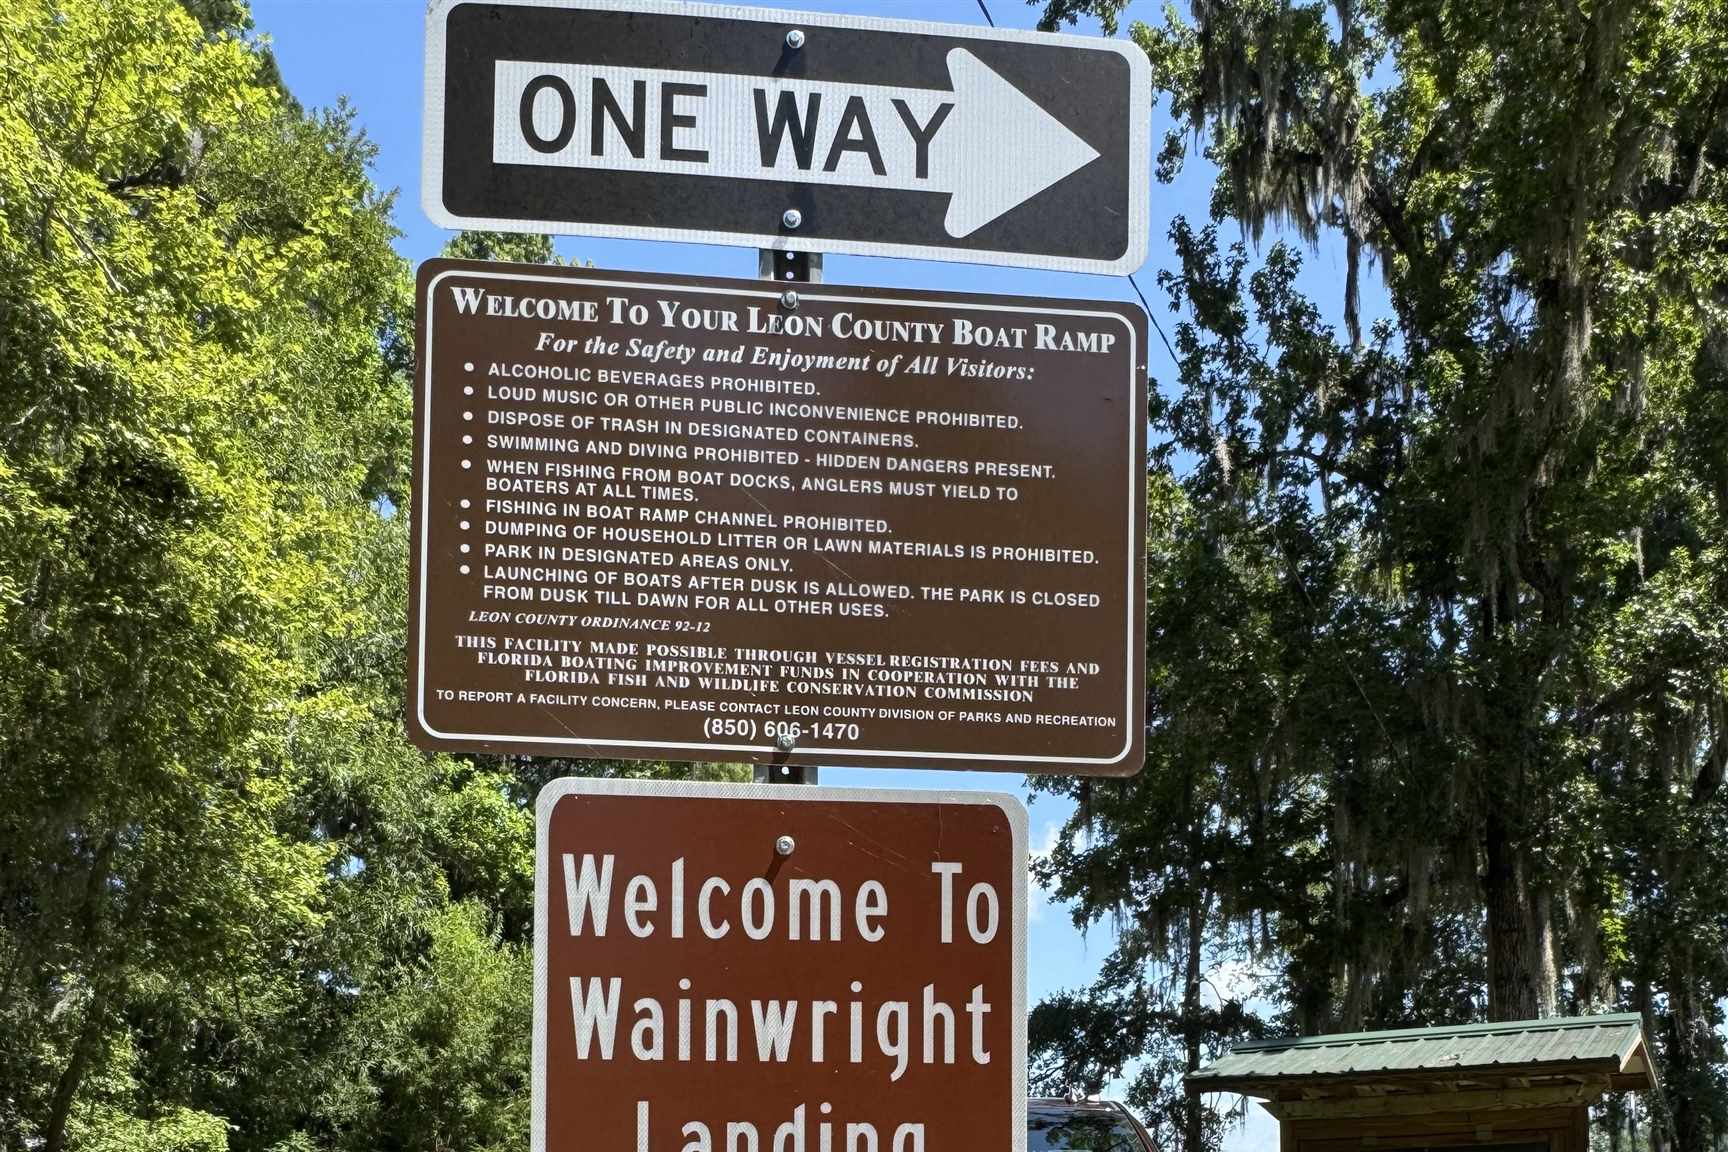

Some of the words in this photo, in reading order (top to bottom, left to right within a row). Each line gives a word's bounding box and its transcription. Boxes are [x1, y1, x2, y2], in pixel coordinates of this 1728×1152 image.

[518, 74, 710, 163] ONE
[751, 88, 955, 179] WAY
[449, 286, 599, 323] WELCOME
[606, 296, 649, 326] TO
[656, 300, 740, 332] YOUR
[746, 305, 824, 338] LEON
[831, 312, 945, 344] COUNTY
[951, 318, 1028, 349] BOAT
[1033, 323, 1116, 354] RAMP
[535, 332, 578, 353] For
[584, 335, 620, 356] the
[625, 338, 696, 365] Safety
[702, 344, 746, 364] and
[749, 347, 871, 373] Enjoyment
[876, 354, 903, 378] of
[903, 355, 939, 375] All
[947, 357, 1035, 381] Visitors:
[488, 362, 591, 382] ALCOHOLIC
[597, 369, 705, 389] BEVERAGES
[710, 375, 821, 396] PROHIBITED.
[488, 385, 537, 401] LOUD
[542, 388, 598, 405] MUSIC
[604, 392, 629, 407] OR
[634, 394, 694, 412] OTHER
[700, 398, 764, 415] PUBLIC
[769, 402, 910, 424] INCONVENIENCE
[916, 410, 1023, 429] PROHIBITED.
[487, 410, 565, 428] DISPOSE
[571, 415, 595, 430] OF
[600, 417, 659, 434] TRASH
[665, 420, 682, 435] IN
[688, 421, 799, 442] DESIGNATED
[804, 428, 919, 448] CONTAINERS.
[487, 434, 580, 453] SWIMMING
[585, 440, 622, 455] AND
[628, 442, 688, 459] DIVING
[693, 446, 799, 465] PROHIBITED
[816, 452, 880, 470] HIDDEN
[886, 457, 969, 474] DANGERS
[975, 461, 1055, 479] PRESENT.
[486, 459, 539, 476] WHEN
[545, 462, 616, 480] FISHING
[622, 467, 671, 483] FROM
[677, 470, 725, 486] BOAT
[730, 472, 796, 492] DOCKS,
[801, 476, 883, 494] ANGLERS
[889, 481, 937, 497] MUST
[942, 484, 991, 500] YIELD
[996, 487, 1019, 501] TO
[486, 476, 569, 495] BOATERS
[575, 482, 597, 496] AT
[602, 483, 636, 499] ALL
[641, 485, 699, 502] TIMES.
[486, 498, 557, 517] FISHING
[563, 503, 580, 517] IN
[586, 504, 634, 520] BOAT
[639, 507, 689, 523] RAMP
[694, 510, 778, 528] CHANNEL
[783, 514, 892, 533] PROHIBITED.
[485, 520, 567, 538] DUMPING
[572, 525, 597, 540] OF
[602, 526, 712, 546] HOUSEHOLD
[718, 532, 777, 549] LITTER
[783, 536, 808, 551] OR
[813, 537, 862, 553] LAWN
[868, 540, 964, 558] MATERIALS
[970, 545, 986, 559] IS
[992, 546, 1099, 564] PROHIBITED.
[485, 543, 532, 559] PARK
[538, 546, 555, 561] IN
[562, 547, 674, 566] DESIGNATED
[679, 553, 739, 570] AREAS
[744, 556, 793, 572] ONLY.
[483, 584, 534, 601] FROM
[540, 587, 589, 603] DUSK
[594, 590, 632, 605] TILL
[637, 592, 689, 609] DAWN
[695, 595, 730, 610] FOR
[736, 597, 769, 612] ALL
[774, 599, 833, 615] OTHER
[839, 602, 889, 618] USES.
[484, 564, 588, 584] LAUNCHING
[594, 570, 618, 585] OF
[624, 572, 682, 589] BOATS
[687, 575, 744, 591] AFTER
[751, 578, 798, 594] DUSK
[804, 580, 820, 595] IS
[825, 582, 915, 599] ALLOWED.
[920, 586, 954, 601] THE
[960, 588, 1005, 604] PARK
[1010, 590, 1026, 604] IS
[1032, 591, 1100, 608] CLOSED
[468, 610, 512, 623] LEON
[515, 612, 579, 626] COUNTY
[580, 616, 671, 631] ORDINANCE
[675, 620, 711, 633] 92-12
[525, 669, 600, 685] FLORIDA
[608, 672, 647, 687] FISH
[655, 675, 690, 689] AND
[698, 676, 780, 693] WILDLIFE
[786, 681, 917, 698] CONSERVATION
[924, 686, 1033, 703] COMMISSION
[436, 689, 455, 700] TO
[458, 690, 513, 703] REPORT
[516, 693, 526, 704] A
[529, 693, 588, 706] FACILITY
[664, 699, 716, 712] PLEASE
[719, 701, 781, 715] CONTACT
[784, 705, 819, 716] LEON
[823, 706, 876, 718] COUNTY
[879, 708, 935, 720] DIVISION
[938, 710, 956, 721] OF
[959, 711, 1002, 723] PARKS
[1005, 713, 1032, 724] AND
[1035, 714, 1116, 727] RECREATION
[703, 716, 757, 740] (850)
[764, 720, 859, 741] 606-1470
[562, 853, 889, 944] Welcome
[931, 862, 1000, 945] To
[569, 976, 992, 1082] Wainwright
